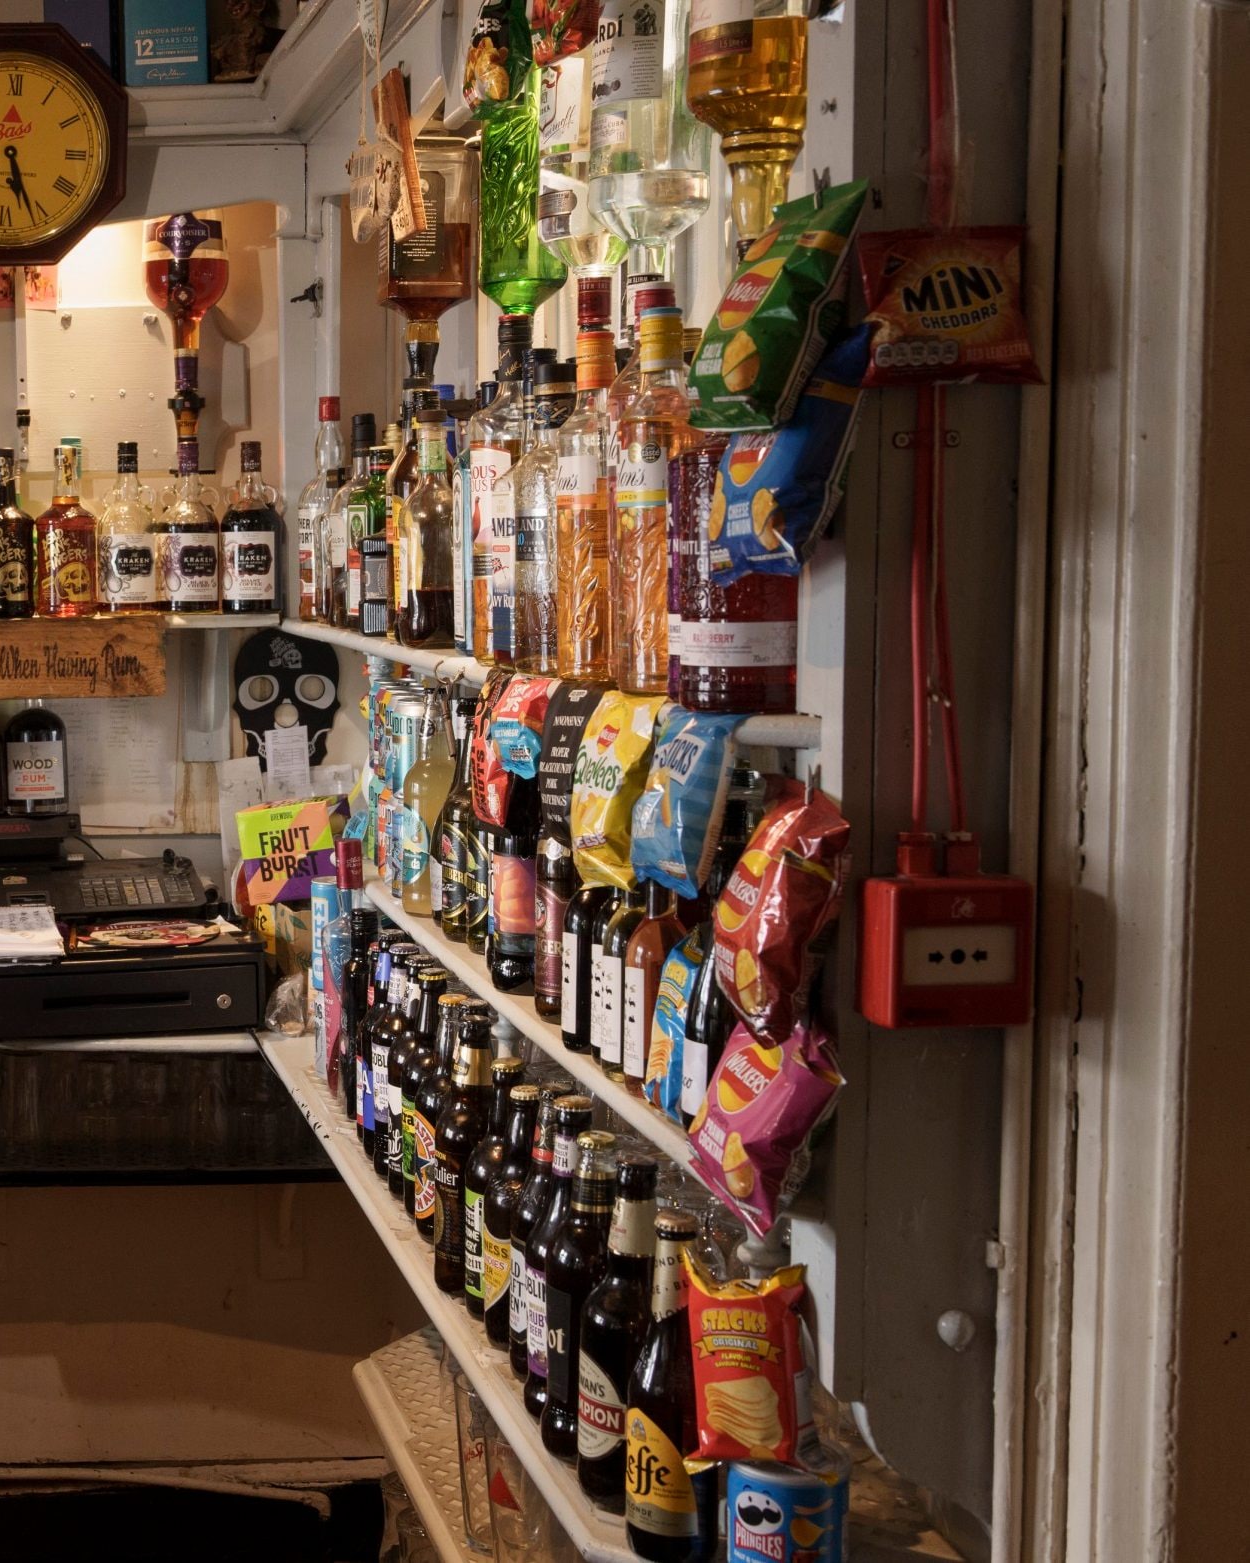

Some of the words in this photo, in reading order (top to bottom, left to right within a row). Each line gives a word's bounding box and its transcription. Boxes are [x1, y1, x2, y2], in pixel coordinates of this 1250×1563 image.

[135, 39, 154, 57] 12
[920, 303, 999, 330] CHEDDARS
[0, 645, 40, 680] When
[44, 642, 98, 693] Having
[101, 641, 141, 681] Rum
[22, 774, 46, 783] RUM
[269, 811, 294, 822] BREWDOG
[259, 851, 319, 882] BURST
[724, 1051, 771, 1096] WALKERS
[701, 1308, 768, 1334] STACKS
[712, 1337, 759, 1351] ORIGINAL
[627, 1444, 671, 1496] effe
[734, 1525, 783, 1561] PRINGLES
